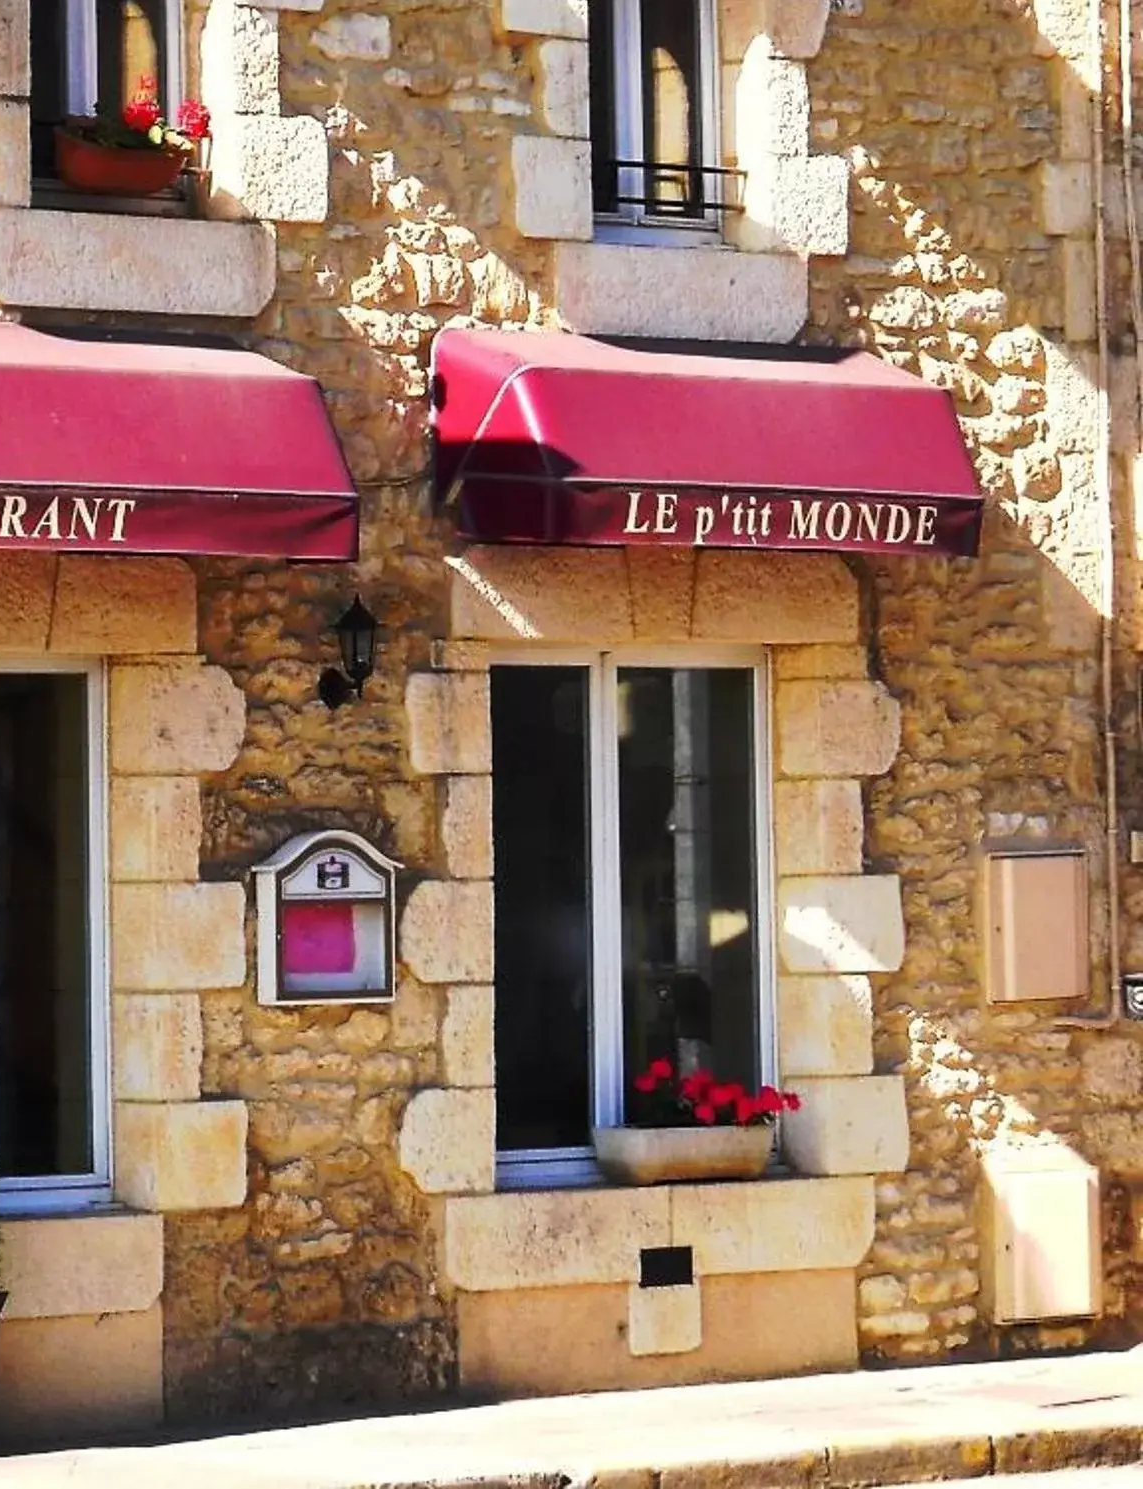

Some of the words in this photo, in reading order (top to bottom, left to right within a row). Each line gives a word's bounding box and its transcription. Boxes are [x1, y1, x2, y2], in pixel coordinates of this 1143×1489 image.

[623, 491, 679, 534] LE
[693, 495, 773, 545] p'tit
[787, 499, 939, 545] MONDE
